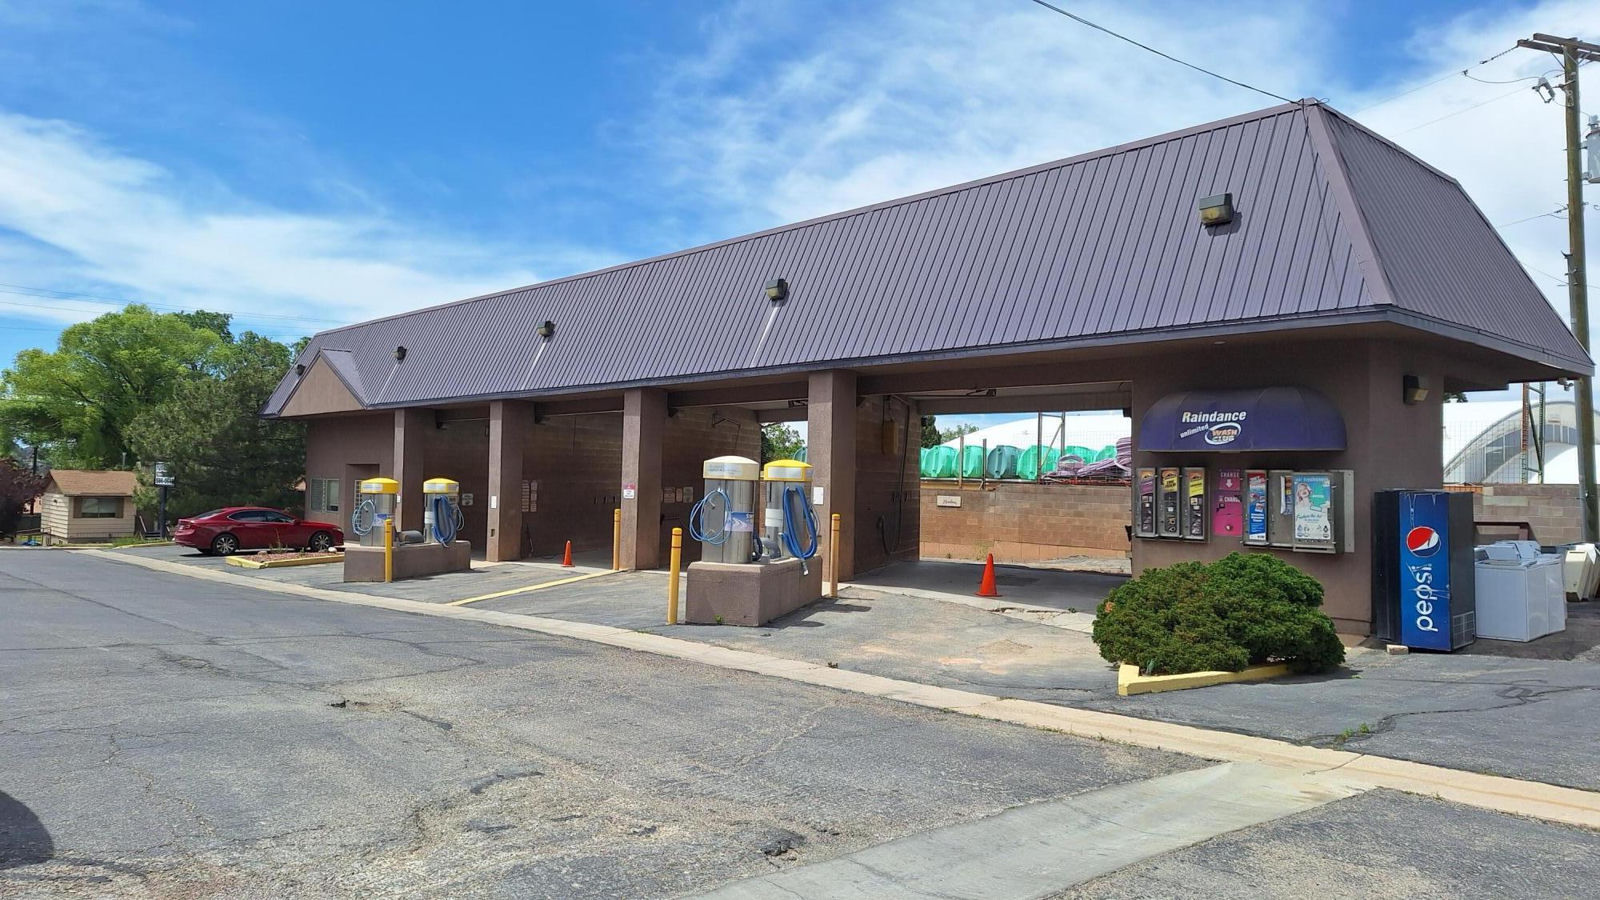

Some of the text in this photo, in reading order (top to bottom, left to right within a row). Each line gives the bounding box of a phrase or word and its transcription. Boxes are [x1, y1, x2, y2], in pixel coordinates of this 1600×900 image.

[1182, 411, 1247, 423] Raindance
[1180, 423, 1209, 438] unlimited
[1211, 429, 1238, 437] WASH
[1415, 563, 1439, 632] pepsi
